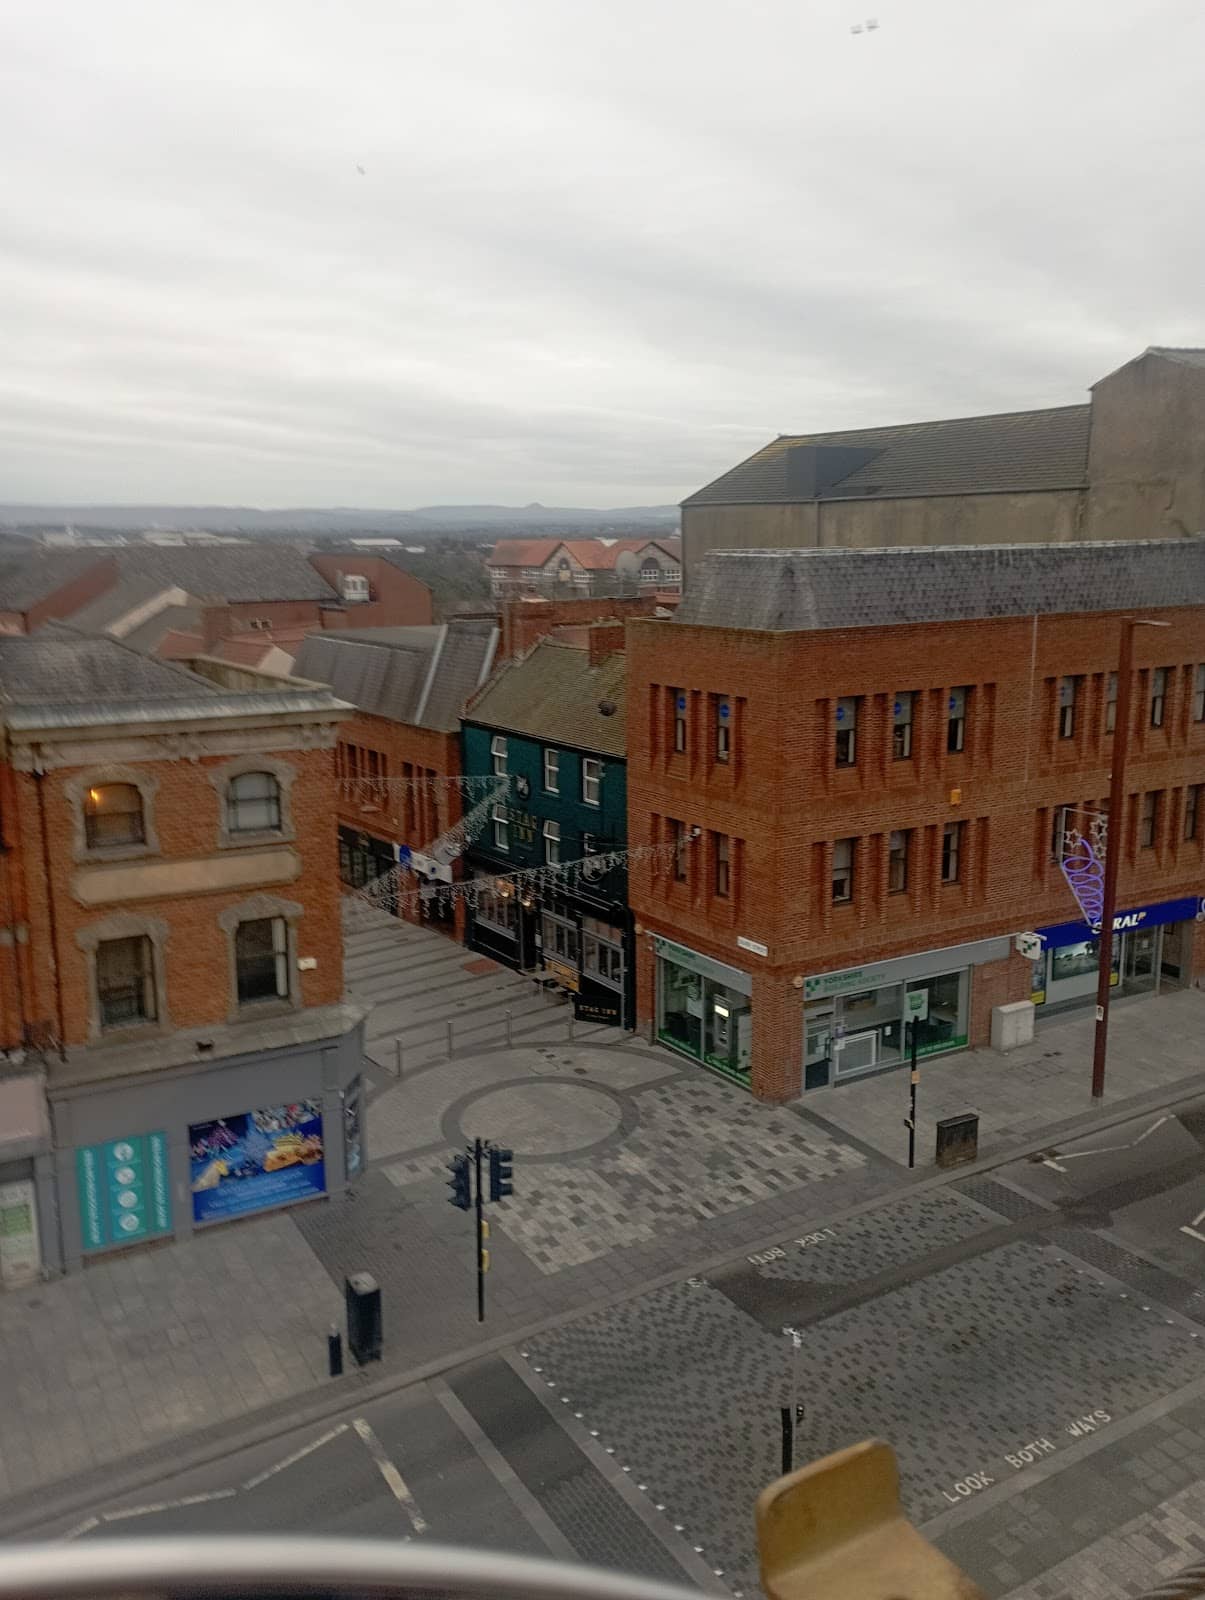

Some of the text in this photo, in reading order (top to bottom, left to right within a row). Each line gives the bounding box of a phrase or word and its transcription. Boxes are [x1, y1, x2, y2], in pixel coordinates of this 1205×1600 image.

[1091, 914, 1138, 934] CRAL
[941, 1409, 1112, 1503] LOOK BOTH WAYS
